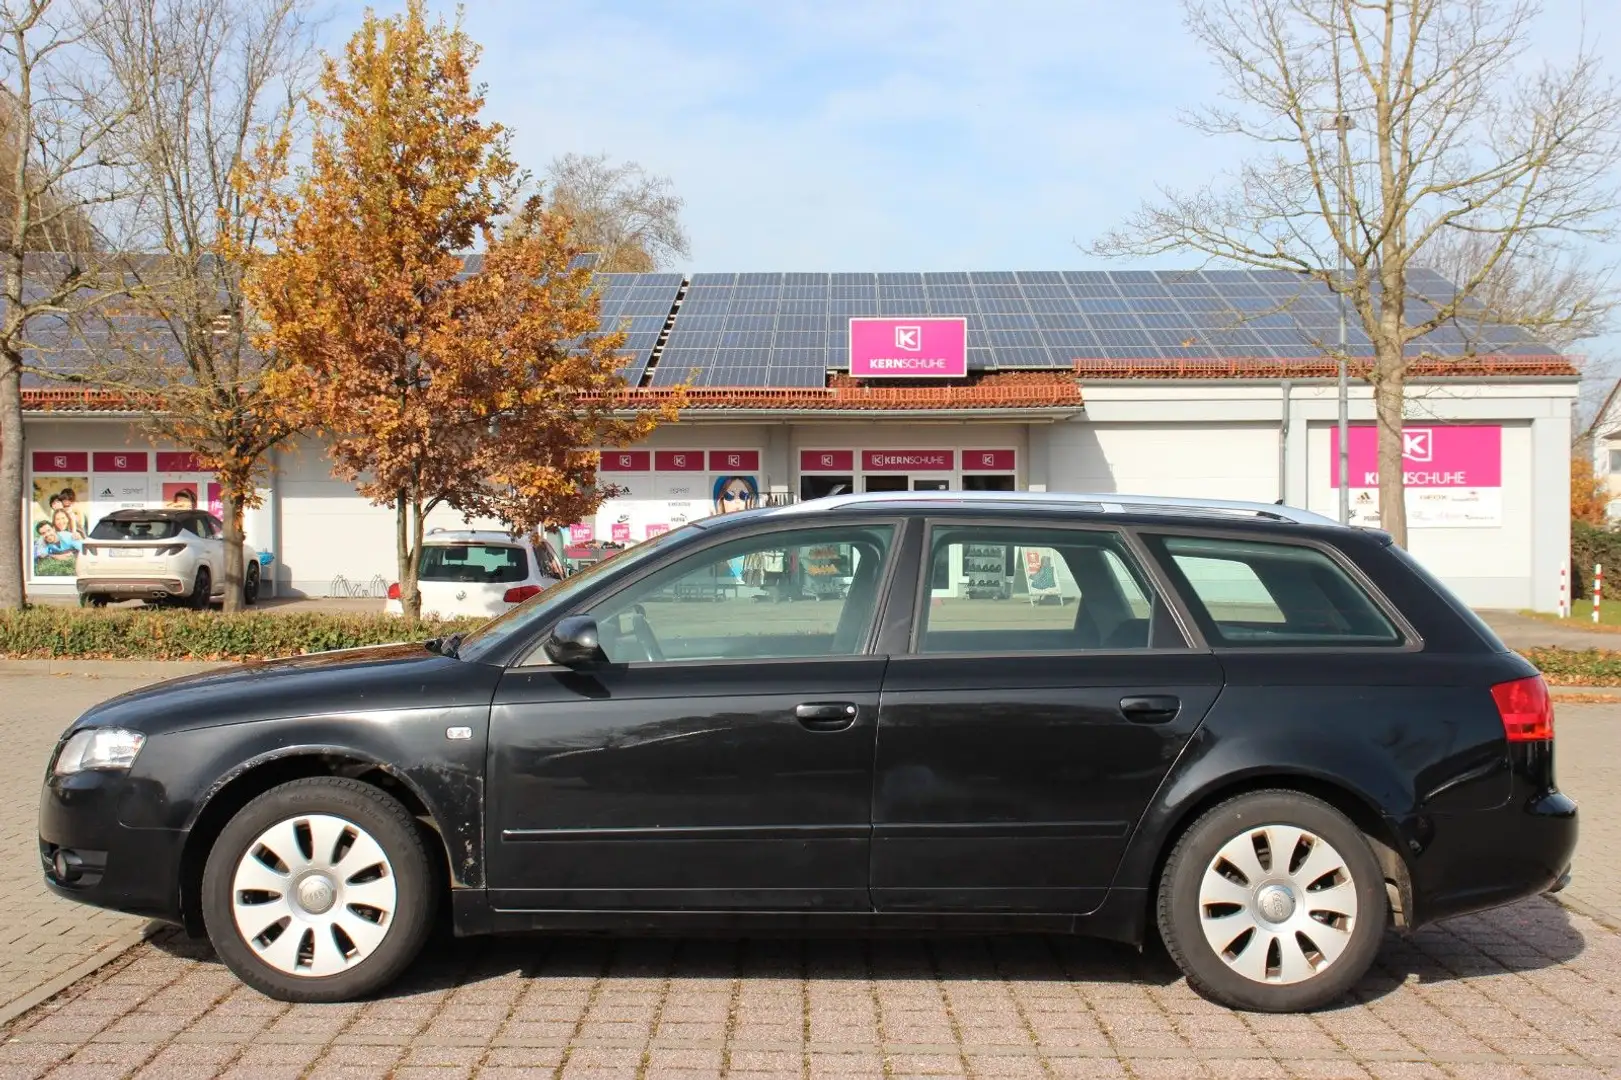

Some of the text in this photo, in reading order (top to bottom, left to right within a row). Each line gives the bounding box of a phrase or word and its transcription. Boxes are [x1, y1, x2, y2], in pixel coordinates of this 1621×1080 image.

[869, 358, 947, 369] KERNSCHUHE
[884, 455, 945, 464] KERNSCHUHE
[1364, 471, 1467, 485] KSCHUHE
